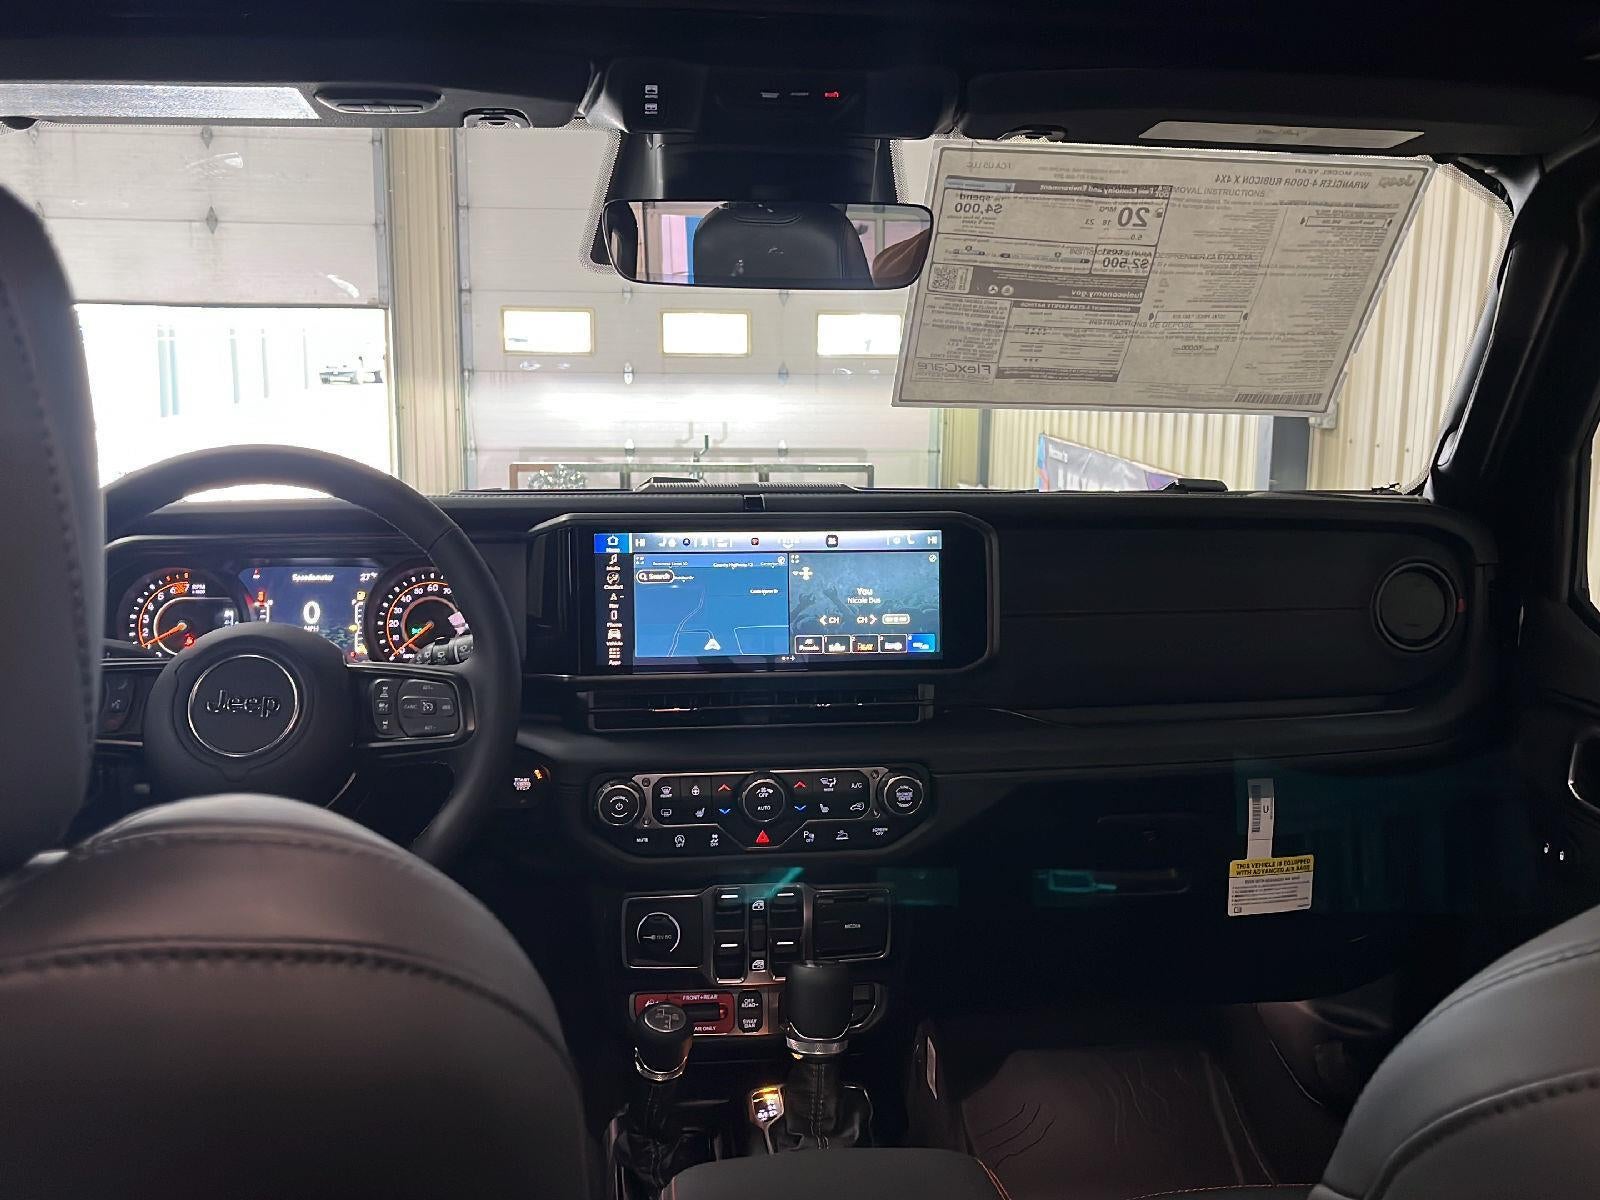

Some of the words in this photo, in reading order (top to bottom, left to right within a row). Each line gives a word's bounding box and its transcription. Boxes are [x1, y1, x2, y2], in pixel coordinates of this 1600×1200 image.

[1203, 188, 1265, 198] INSTRUCTIONS
[292, 573, 335, 582] Speedometer
[648, 572, 671, 580] Search
[427, 584, 439, 592] 60
[856, 587, 873, 596] You
[401, 594, 413, 603] 40
[303, 600, 321, 625] 0
[143, 614, 150, 624] 3
[388, 619, 400, 628] 20
[142, 628, 149, 637] 2
[205, 688, 281, 718] Jeep
[1263, 805, 1269, 814] U
[1251, 861, 1276, 869] VEHICLE
[1283, 858, 1311, 866] EQUIPPED
[1252, 867, 1284, 875] ADVANCED
